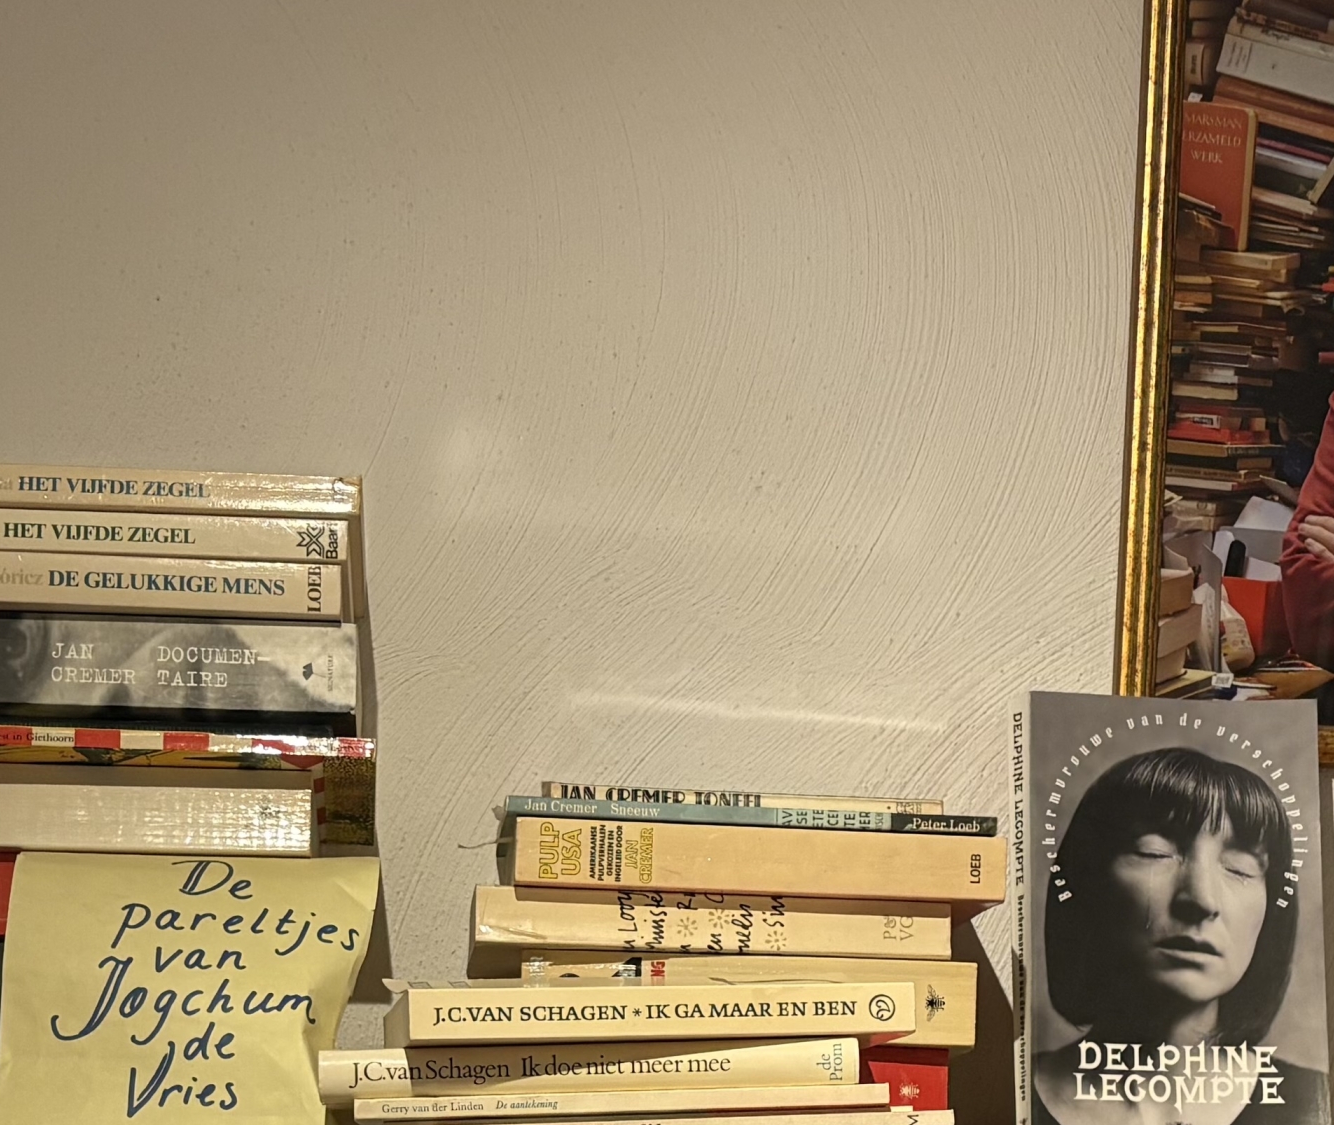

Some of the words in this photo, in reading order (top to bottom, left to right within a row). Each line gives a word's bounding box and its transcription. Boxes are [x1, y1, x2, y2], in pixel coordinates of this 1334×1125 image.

[3, 522, 46, 538] HET
[51, 524, 123, 542] VIJFDE
[128, 525, 195, 545] ZEGEL
[48, 570, 81, 588] DE
[83, 571, 216, 594] GELUKKIGE
[221, 576, 285, 596] MENS
[52, 642, 93, 659] JAN
[51, 666, 135, 684] CREMER
[157, 671, 227, 688] TAIRE
[172, 860, 253, 898] De
[112, 903, 359, 955] pareltjes
[155, 947, 246, 971] van
[520, 1003, 627, 1024] SCHAGEN
[646, 1003, 669, 1020] IK
[673, 1003, 704, 1020] GA
[708, 1002, 772, 1019] MAAR
[776, 1000, 805, 1018] EN
[813, 1000, 856, 1017] BEN
[184, 1022, 235, 1059] de
[1078, 1040, 1278, 1074] DELPHINE
[127, 1041, 236, 1118] Vries
